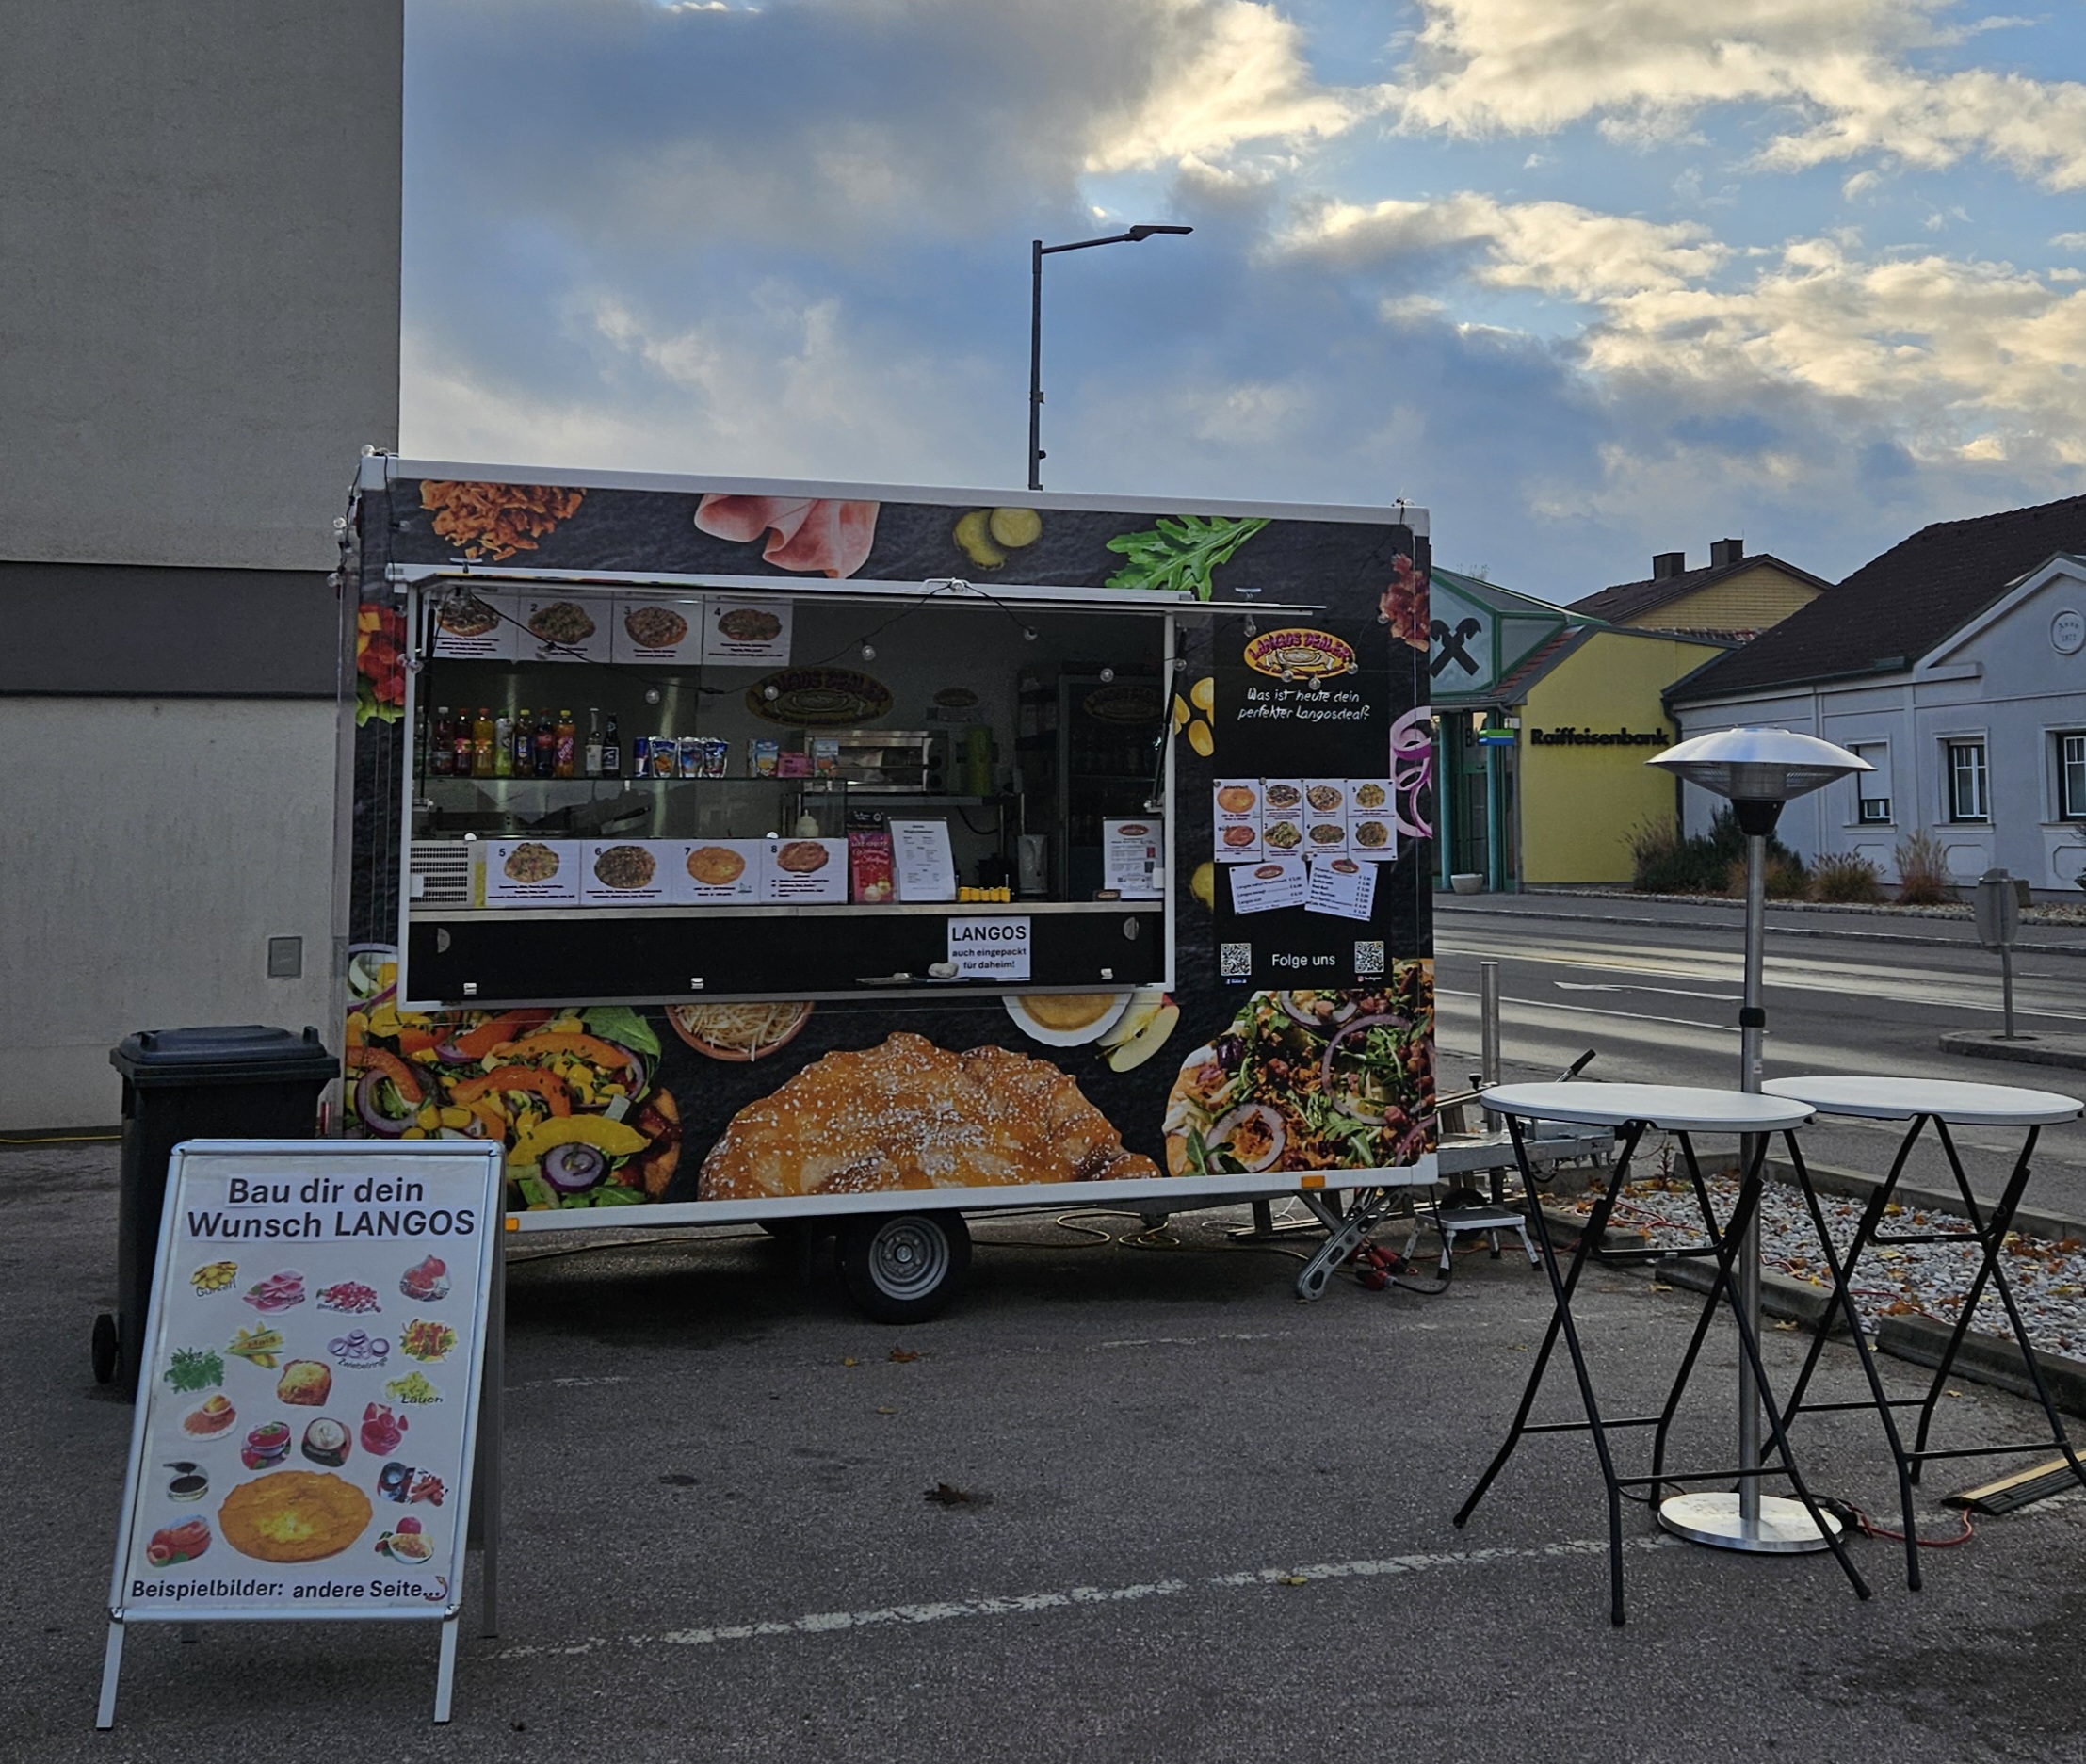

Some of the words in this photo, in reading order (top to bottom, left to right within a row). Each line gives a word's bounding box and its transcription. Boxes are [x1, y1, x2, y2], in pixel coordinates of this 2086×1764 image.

[530, 604, 538, 613] 2
[624, 606, 632, 615] 3
[714, 607, 720, 616] 4
[1247, 632, 1302, 661] LANGOS
[1302, 632, 1352, 663] DEALER
[1247, 687, 1271, 701] Was
[1274, 688, 1295, 701] ist
[1295, 689, 1333, 702] heute
[1333, 690, 1360, 703] dein
[1237, 704, 1293, 721] perfekter
[1295, 704, 1371, 722] Langosdeal?
[1530, 727, 1670, 745] Raiffeisenbank
[498, 849, 506, 857] 5
[595, 847, 602, 855] 6
[684, 847, 691, 855] 7
[770, 845, 778, 853] 8
[952, 925, 1027, 941] LANGOS
[952, 948, 975, 957] auch
[977, 947, 1027, 958] eingepackt
[963, 961, 977, 969] für
[978, 961, 1015, 969] daheim!
[1271, 953, 1308, 969] Folge
[1312, 955, 1336, 966] uns
[228, 1178, 290, 1203] Bau
[299, 1177, 345, 1203] dir
[354, 1177, 423, 1202] dein
[187, 1211, 322, 1238] Wunsch
[334, 1209, 476, 1236] LANGOS
[132, 1579, 283, 1601] Beispielbilder:
[292, 1581, 364, 1598] andere
